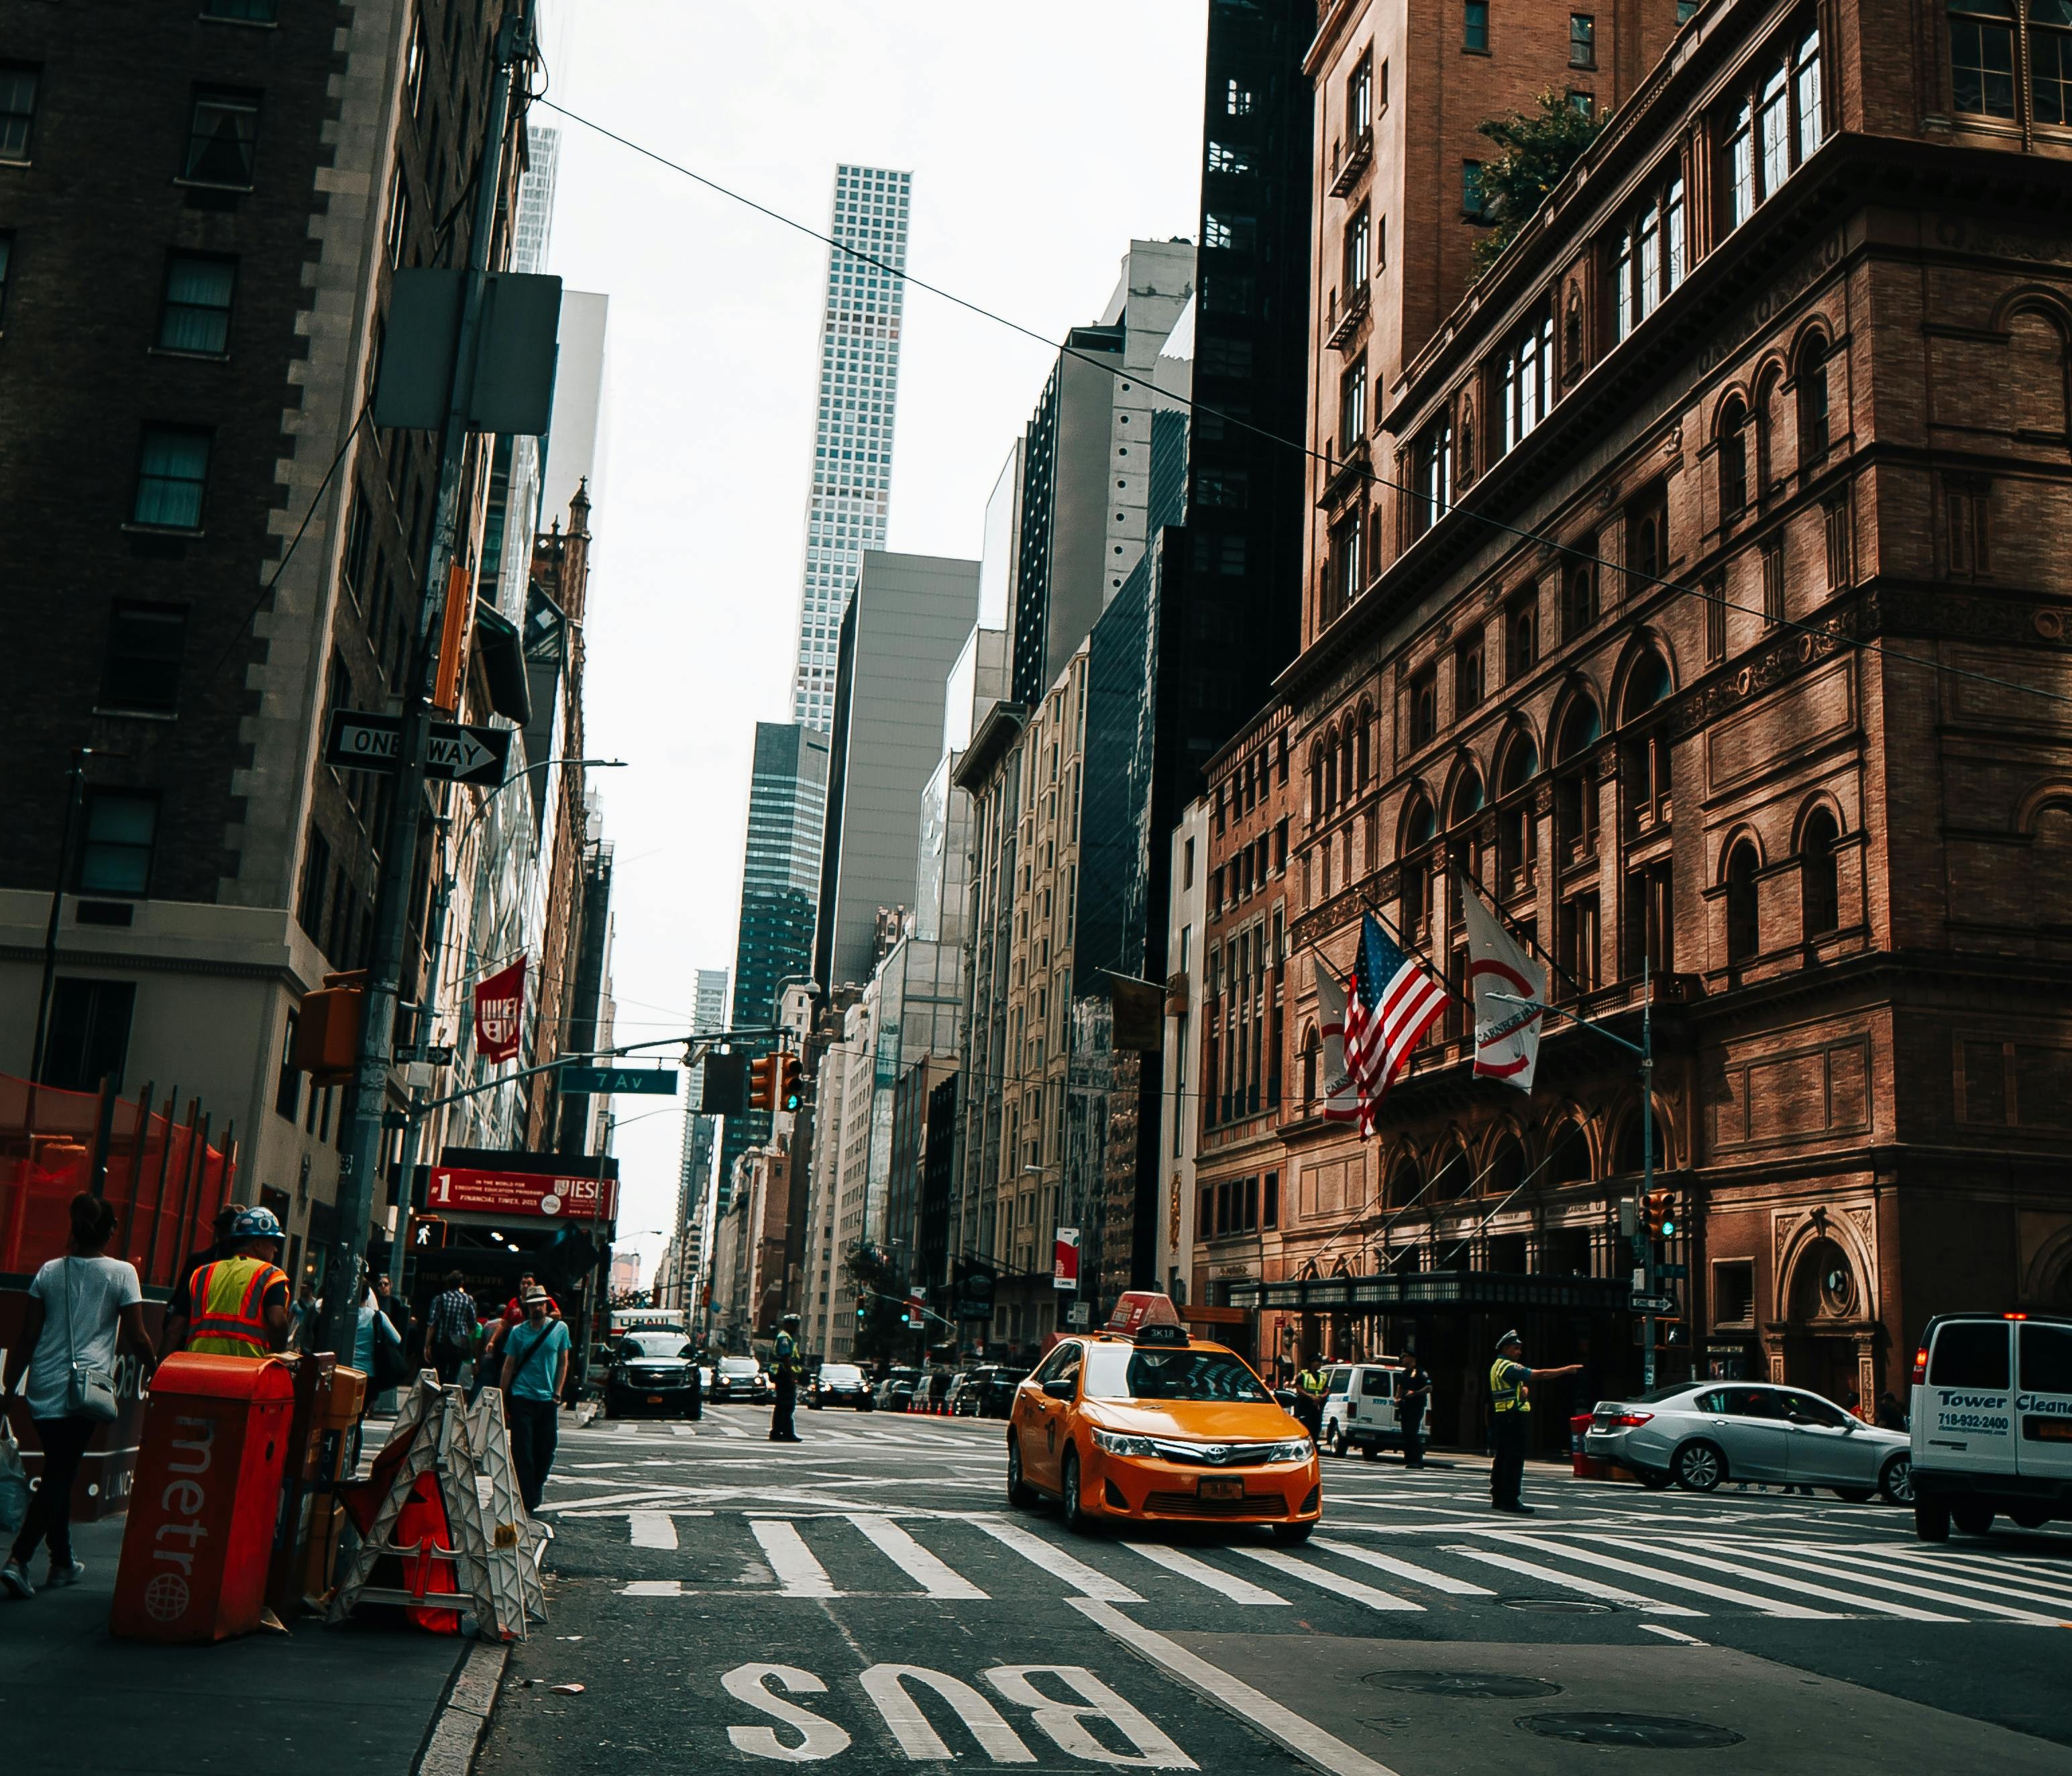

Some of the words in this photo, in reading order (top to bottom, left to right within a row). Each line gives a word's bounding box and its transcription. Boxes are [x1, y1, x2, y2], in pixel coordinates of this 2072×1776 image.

[428, 739, 481, 766] WAY
[1478, 1010, 1523, 1043] CARNEGIE
[596, 1074, 606, 1088] 7
[614, 1074, 642, 1088] Av
[459, 1194, 495, 1203] FINANCIAL
[1151, 1328, 1175, 1338] 3K18
[1938, 1390, 2008, 1409] Tower
[1938, 1413, 2009, 1430] 718-932-2400
[720, 1662, 1201, 1770] BUS
